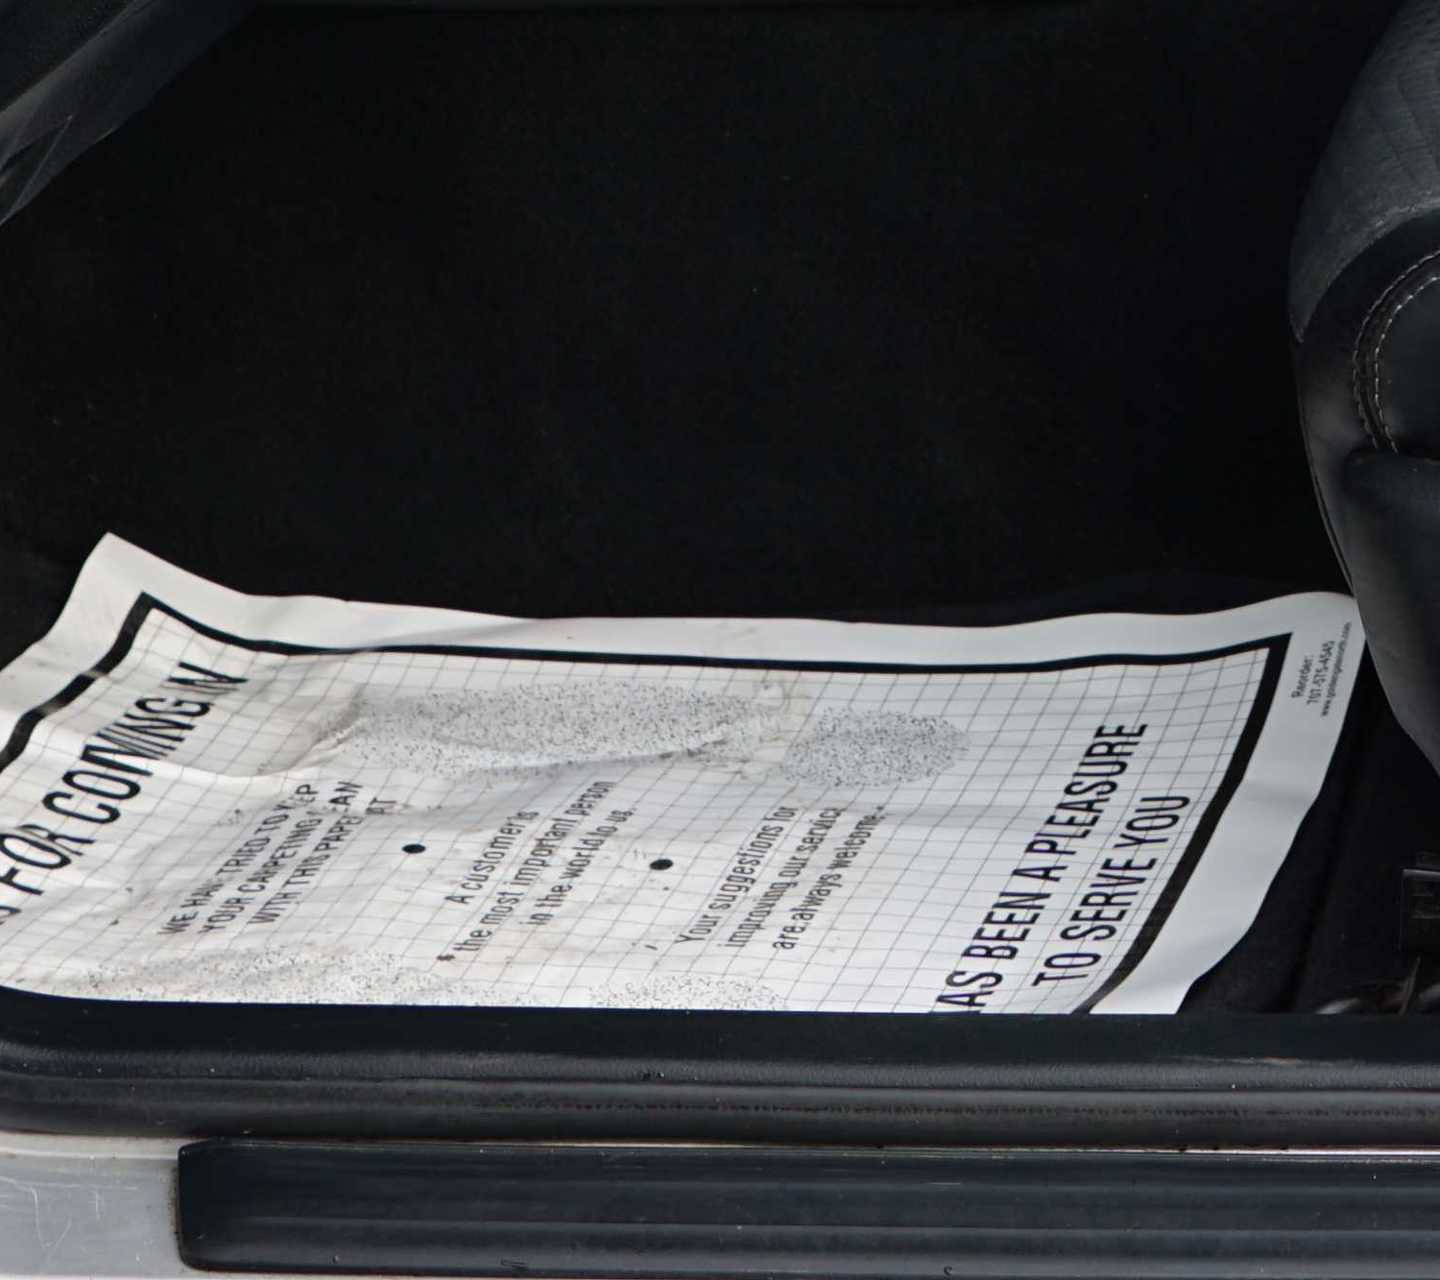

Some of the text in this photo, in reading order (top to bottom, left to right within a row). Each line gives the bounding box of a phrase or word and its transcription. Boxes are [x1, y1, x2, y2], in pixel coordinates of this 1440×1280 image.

[41, 695, 215, 825] COMING
[161, 660, 250, 696] IN
[157, 910, 200, 935] WE
[215, 838, 272, 876] TRIED
[254, 813, 290, 834] TO
[197, 896, 256, 935] YOUR
[237, 817, 324, 893] CARPETING
[246, 891, 303, 925] WITH
[281, 853, 331, 888] THIS
[313, 814, 364, 852] PAPE
[444, 894, 475, 905] A
[460, 822, 527, 891] customer
[452, 780, 617, 952] the most important person
[560, 837, 606, 880] world
[591, 824, 619, 842] to
[673, 805, 801, 944] Your suggestions for
[928, 723, 1149, 1015] AS BEEN A PLEASURE
[519, 912, 555, 926] in
[534, 884, 573, 908] the
[717, 880, 799, 948] improving
[777, 854, 809, 879] our
[771, 924, 808, 951] are
[789, 872, 844, 922] always
[1031, 795, 1191, 987] TO SERVE YOU
